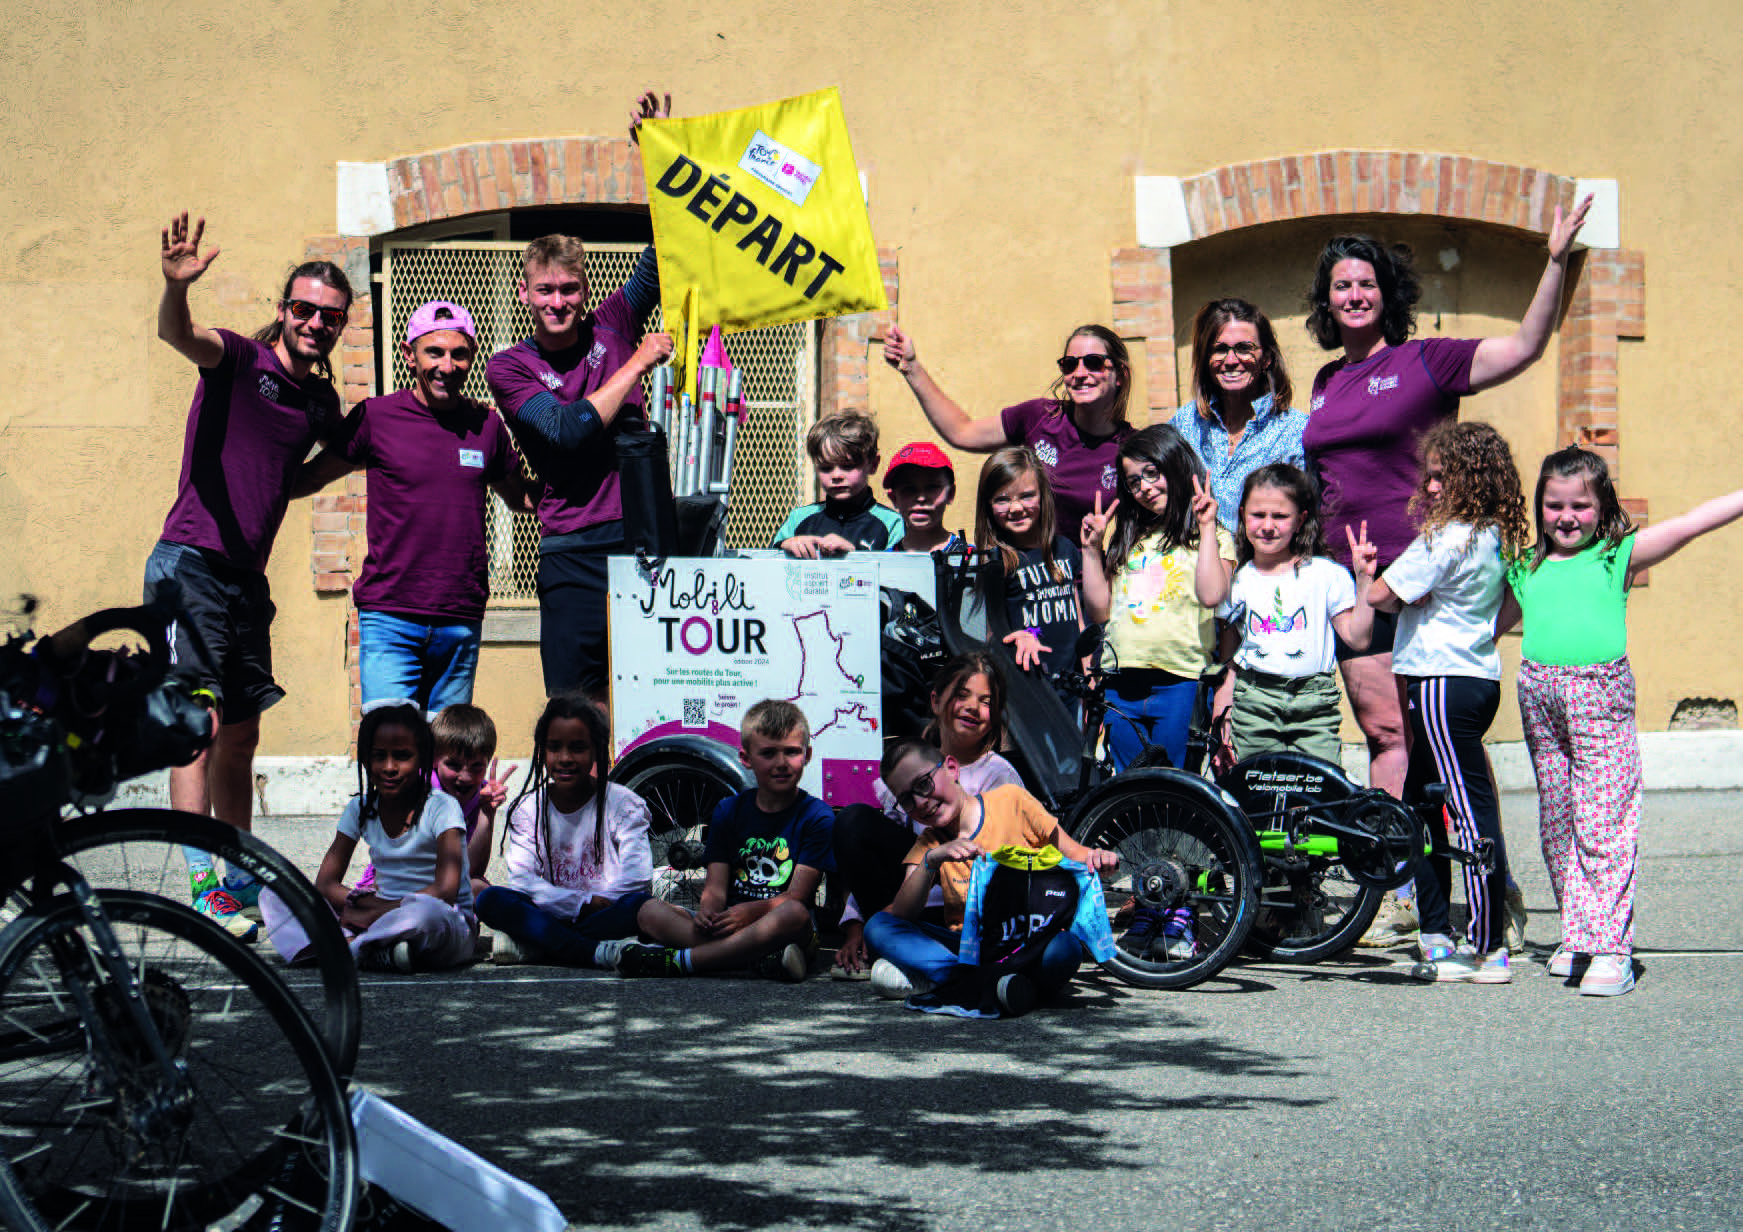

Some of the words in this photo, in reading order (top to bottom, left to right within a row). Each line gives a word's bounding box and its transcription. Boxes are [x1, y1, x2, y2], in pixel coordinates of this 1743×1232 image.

[655, 153, 846, 300] DÉPART
[639, 568, 755, 615] Mobili
[1022, 598, 1077, 627] WOMA
[658, 616, 767, 655] TOUR
[653, 677, 670, 687] pour
[671, 678, 685, 686] une
[715, 678, 731, 688] plus
[732, 678, 754, 687] active
[666, 667, 679, 676] Sur
[680, 668, 690, 676] les
[691, 668, 713, 677] routes
[714, 668, 724, 677] du
